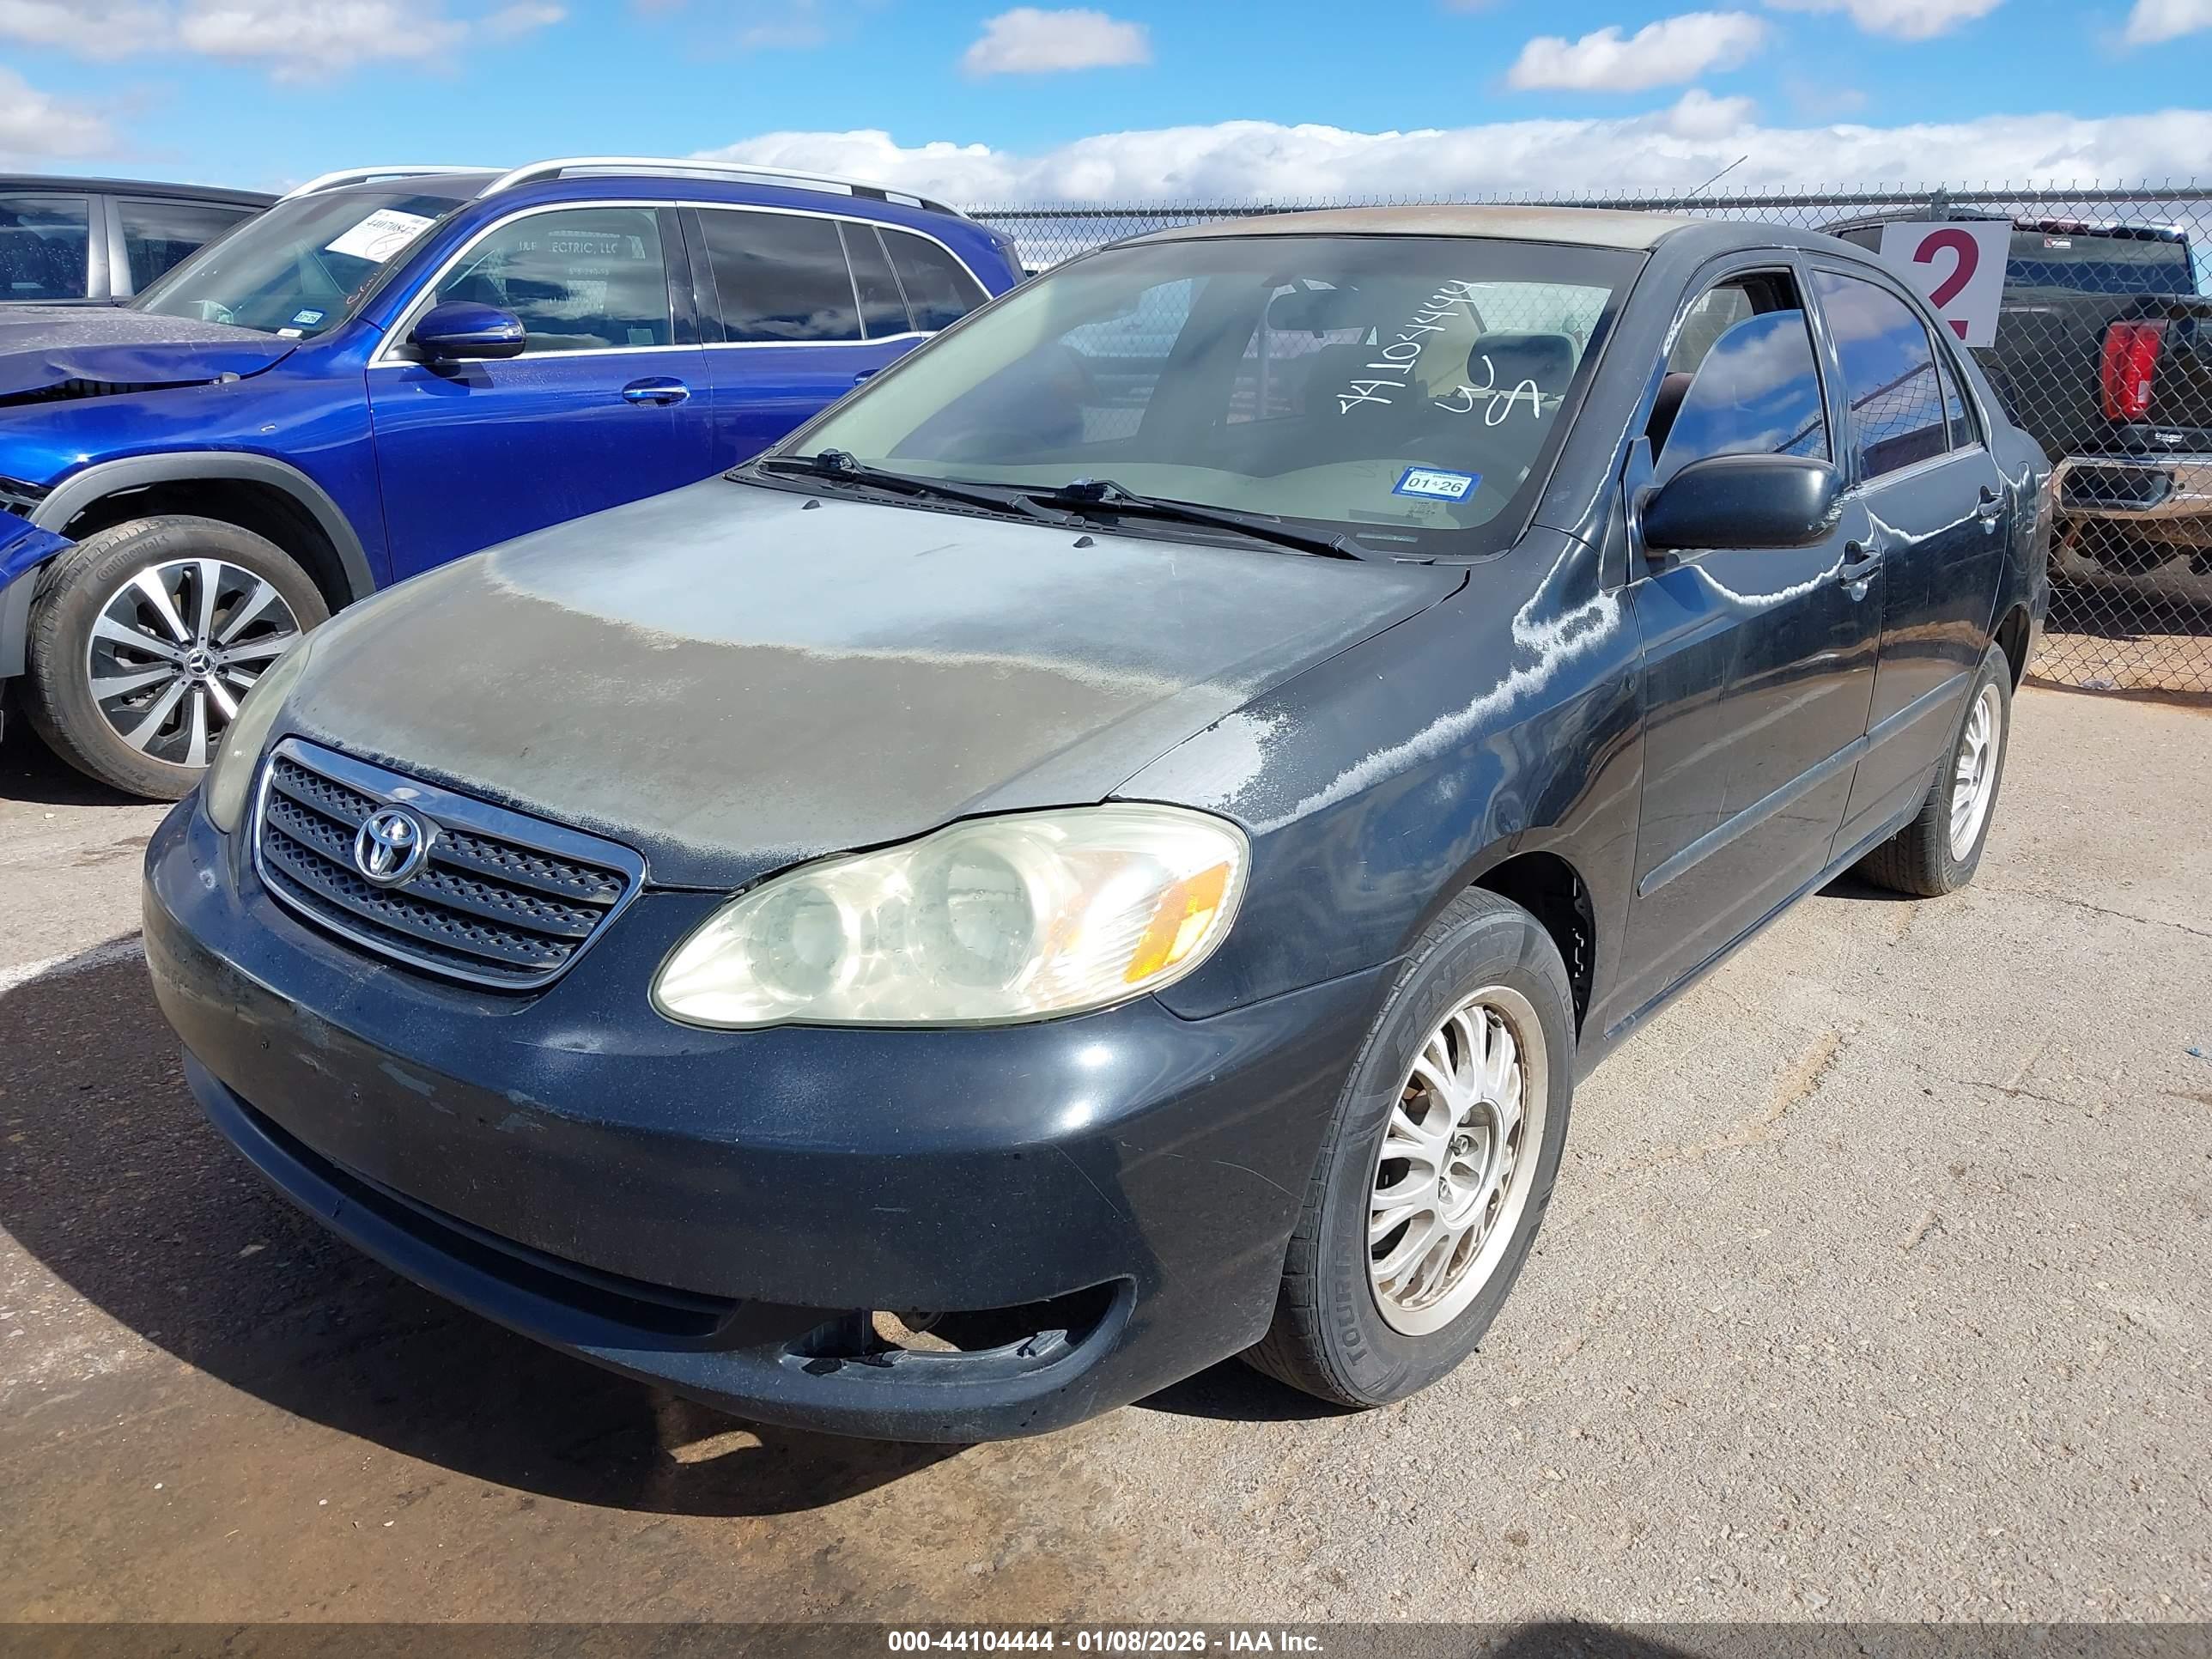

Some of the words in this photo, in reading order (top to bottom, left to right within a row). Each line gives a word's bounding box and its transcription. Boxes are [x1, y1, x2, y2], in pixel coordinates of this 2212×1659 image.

[1913, 228, 1979, 340] 2
[1408, 477, 1431, 489] 01
[1438, 481, 1464, 493] 26
[96, 538, 160, 581] Continental
[1336, 1202, 1368, 1367] TOURING
